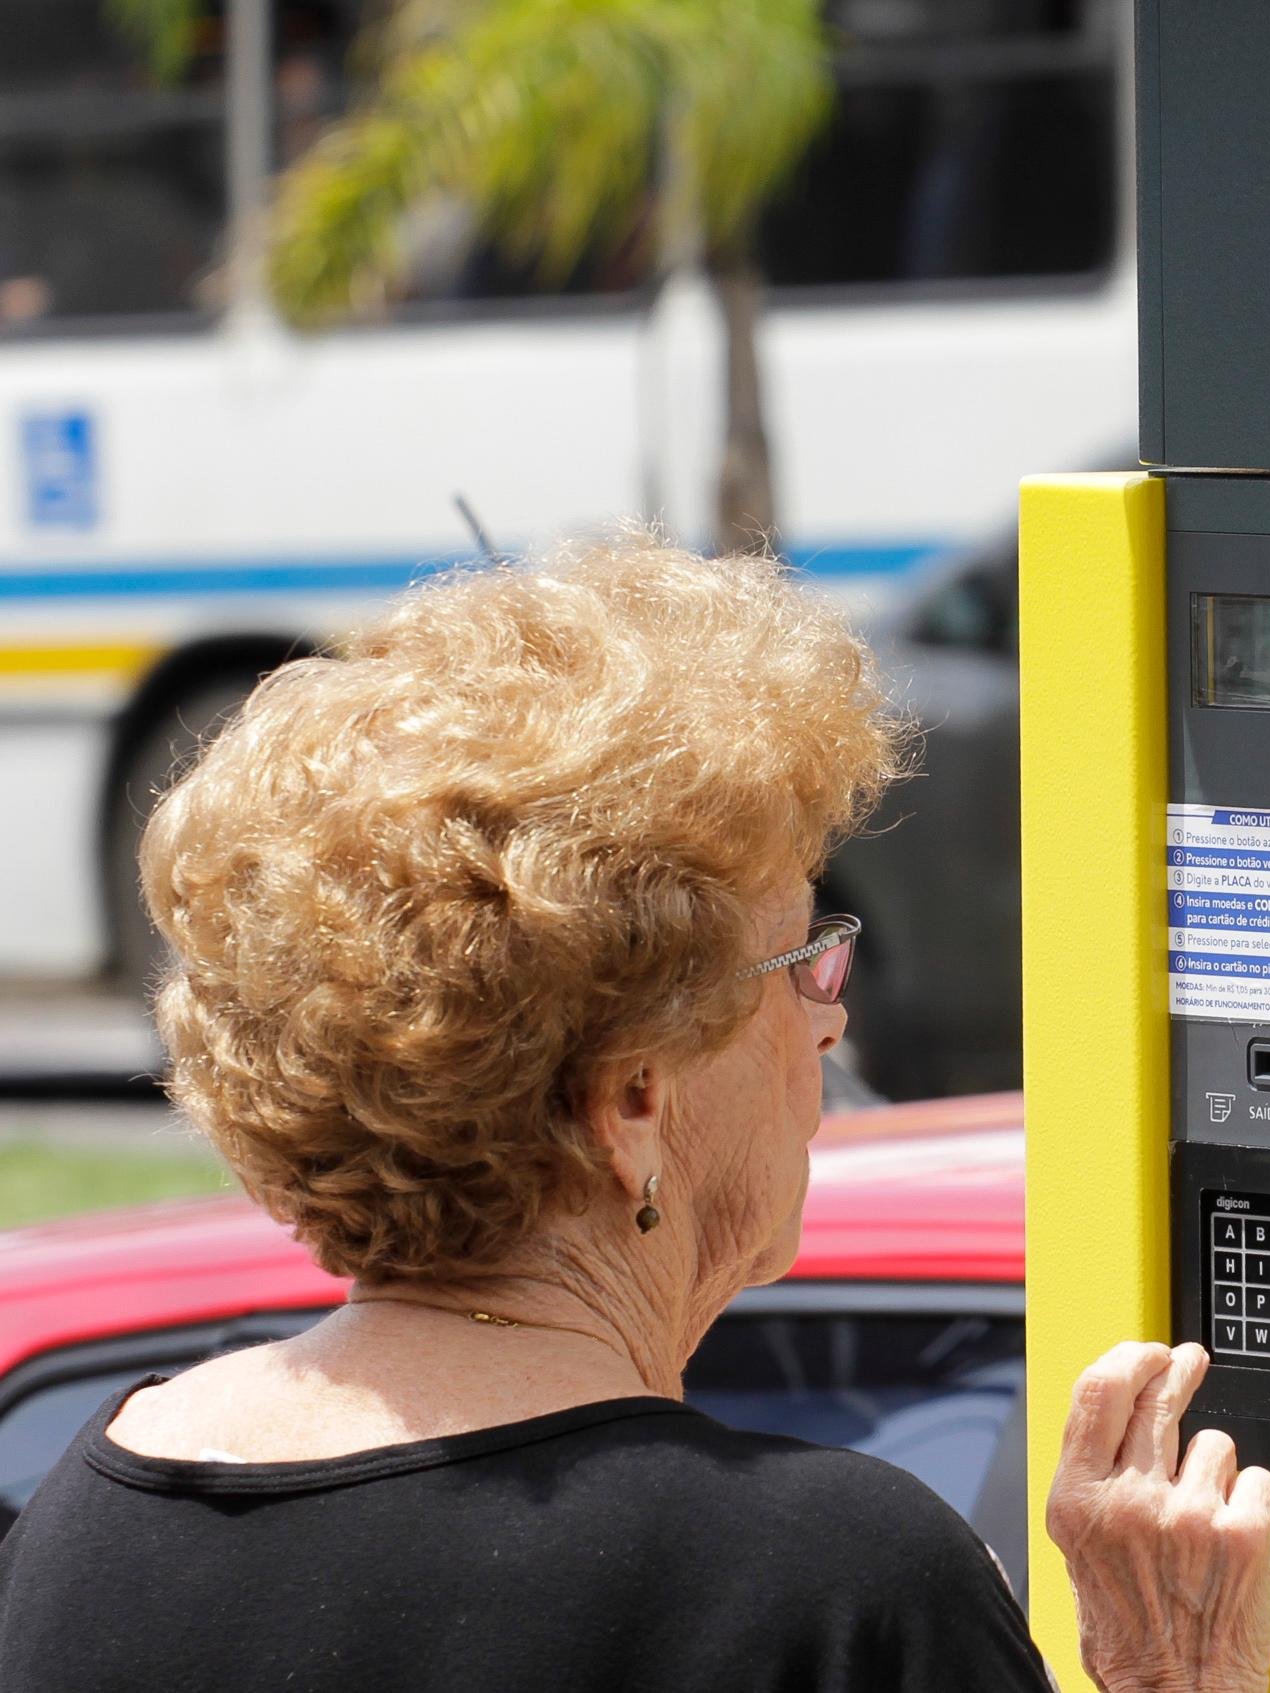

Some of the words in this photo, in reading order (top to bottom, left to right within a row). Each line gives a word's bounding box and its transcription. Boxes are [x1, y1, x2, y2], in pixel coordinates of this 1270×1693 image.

[1229, 814, 1258, 826] COMO
[1186, 832, 1227, 845] Pressione
[1229, 837, 1235, 846] o
[1236, 834, 1261, 847] botão
[1186, 853, 1227, 866] Pressione
[1229, 858, 1235, 867] o
[1237, 855, 1261, 869] botão
[1186, 872, 1212, 888] Digite
[1214, 876, 1219, 886] a
[1221, 875, 1252, 888] PLACA
[1254, 876, 1265, 888] do
[1187, 895, 1211, 908] Insira
[1212, 897, 1246, 910] moedas
[1247, 901, 1253, 910] e
[1187, 915, 1207, 926] para
[1208, 913, 1235, 926] cartão
[1236, 914, 1248, 927] de
[1187, 933, 1228, 947] Pressione
[1230, 938, 1250, 952] para
[1188, 957, 1212, 971] Insira
[1213, 962, 1220, 971] o
[1221, 960, 1248, 973] cartão
[1249, 964, 1261, 974] no
[1175, 996, 1204, 1007] HORÁRIO
[1205, 999, 1214, 1008] DE
[1214, 1000, 1270, 1012] FUNCIONAMENTO
[1216, 1196, 1250, 1211] digicon
[1225, 1224, 1236, 1240] A
[1256, 1227, 1266, 1242] B
[1226, 1258, 1236, 1274] H
[1258, 1261, 1263, 1276] I
[1225, 1292, 1236, 1307] O
[1256, 1294, 1266, 1310] P
[1226, 1326, 1236, 1341] V
[1254, 1328, 1268, 1344] W
